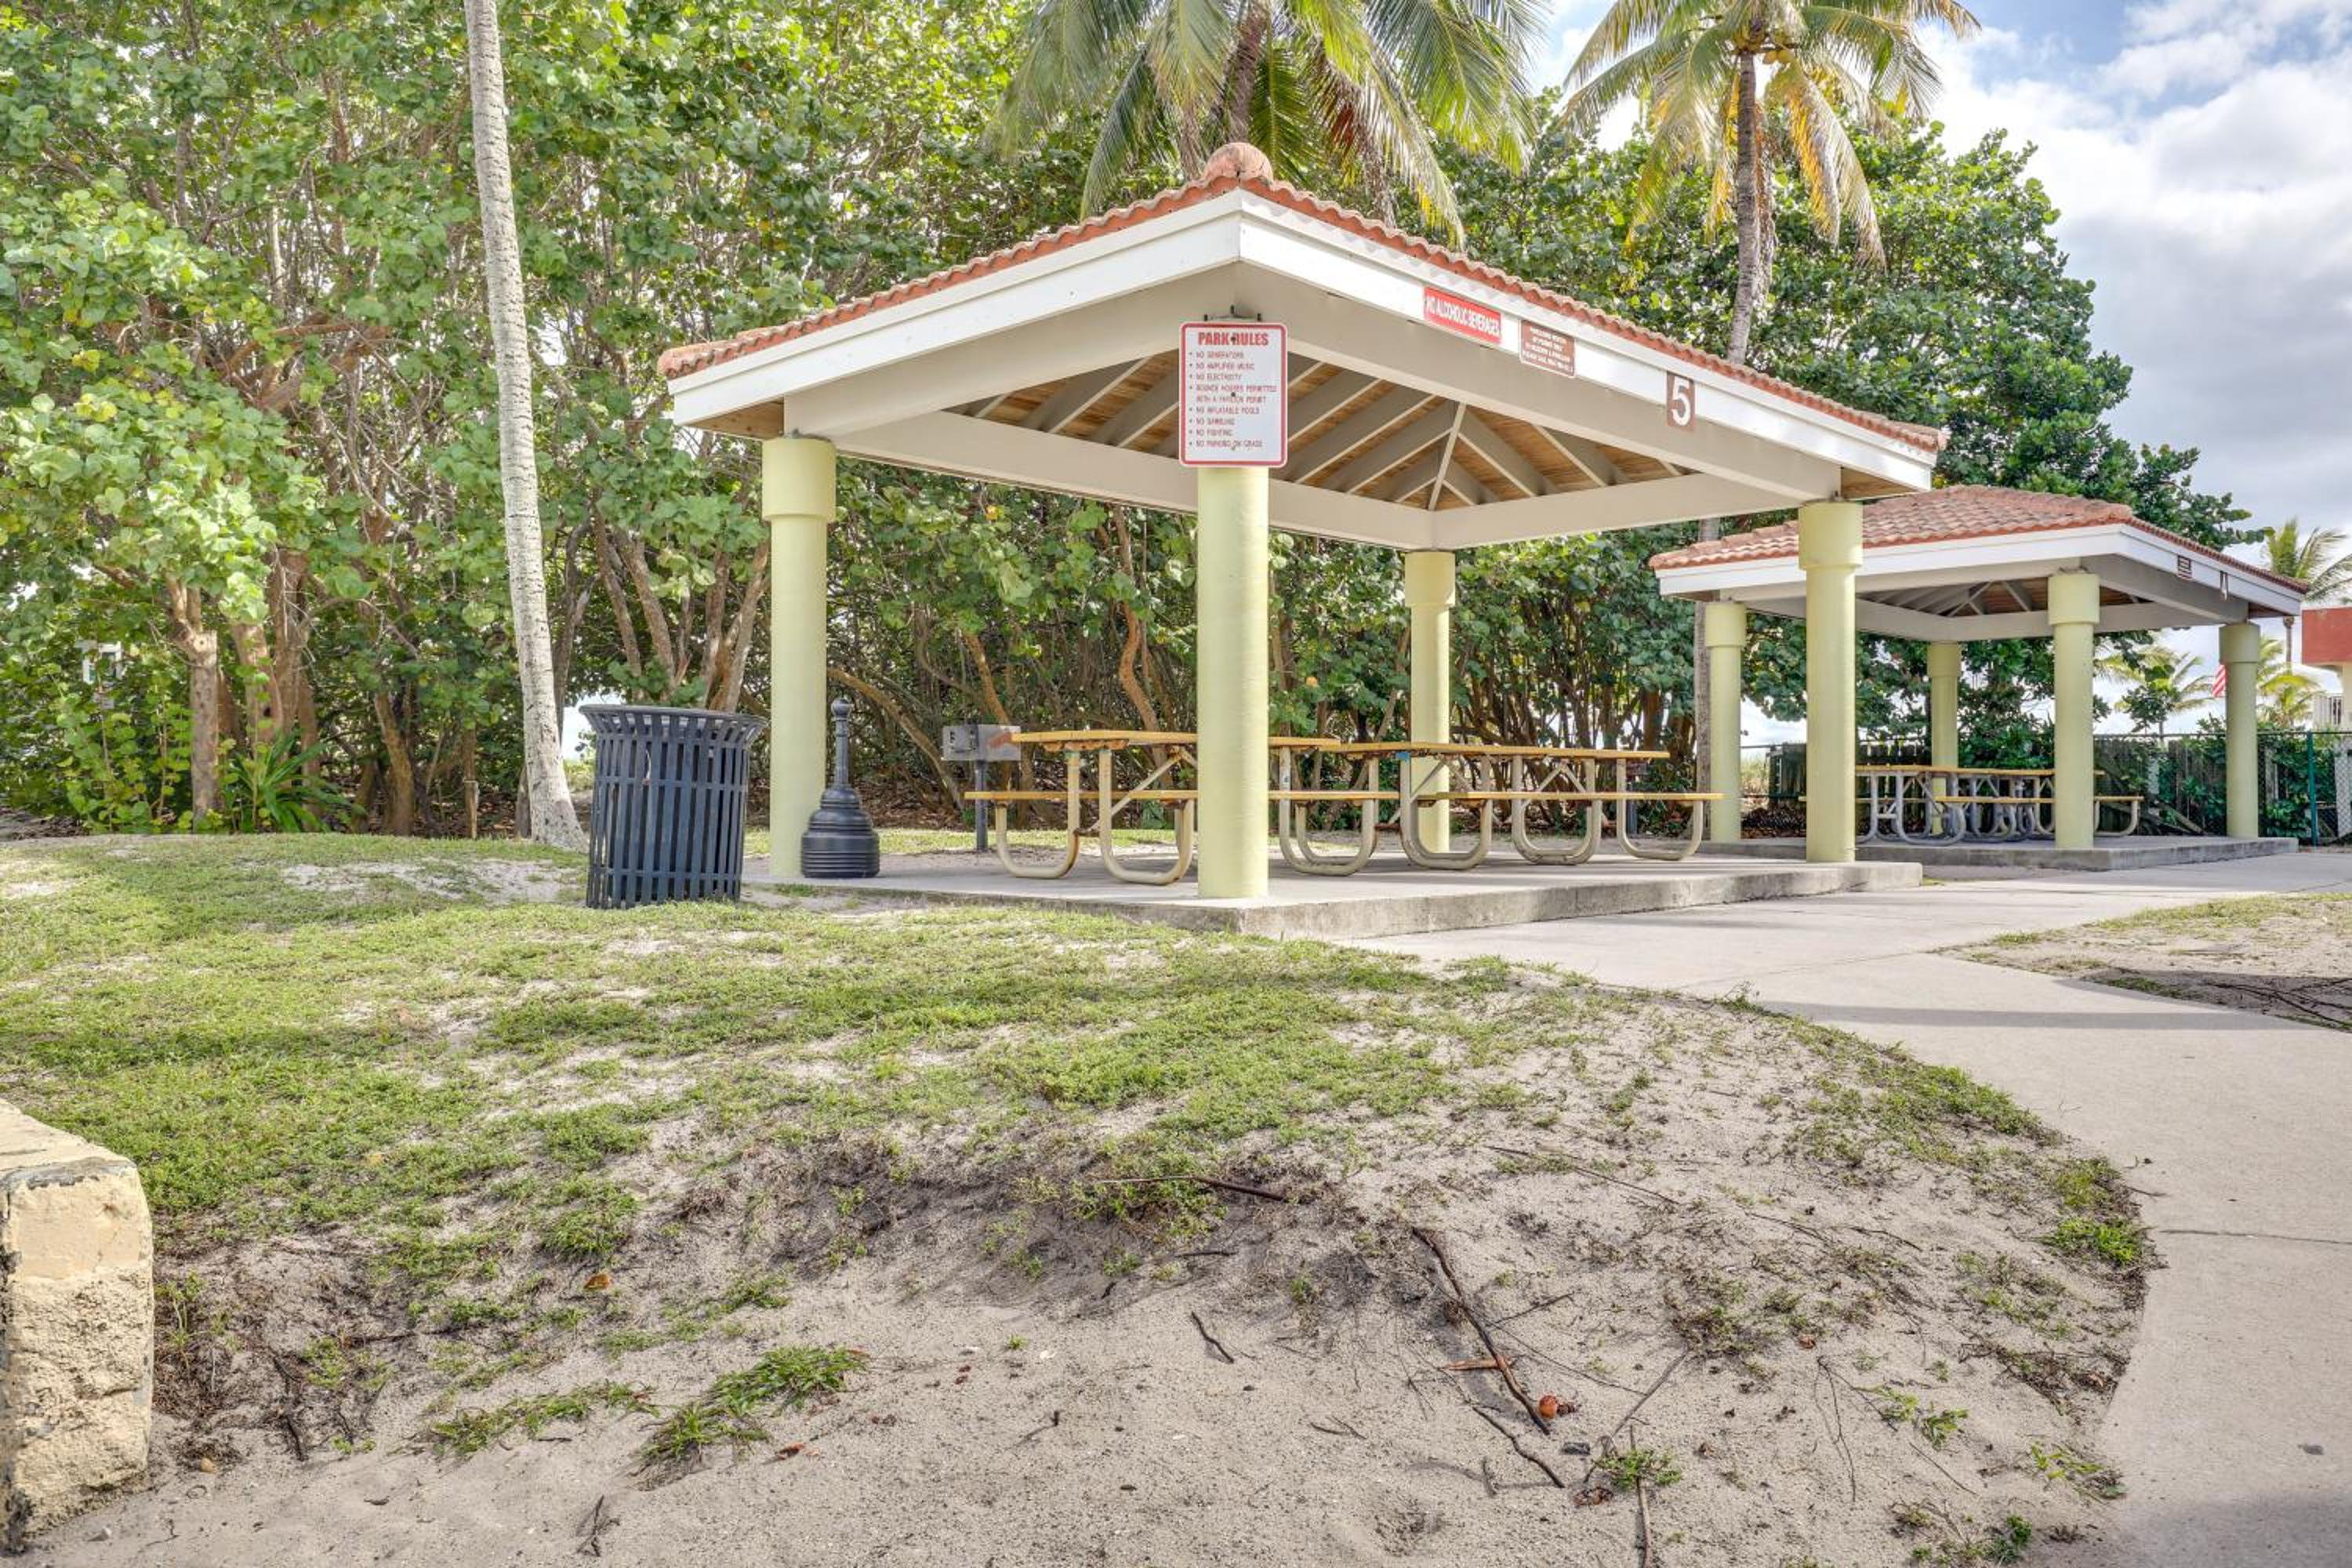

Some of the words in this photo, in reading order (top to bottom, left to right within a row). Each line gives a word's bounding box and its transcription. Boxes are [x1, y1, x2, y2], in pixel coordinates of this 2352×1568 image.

[1198, 332, 1230, 346] PARK
[1232, 332, 1269, 347] RULES
[1196, 350, 1205, 359] NO
[1196, 361, 1205, 370] NO
[1196, 372, 1205, 381] NO
[1671, 375, 1691, 426] 5
[1196, 406, 1205, 415] NO
[1196, 417, 1205, 426] NO
[1196, 428, 1205, 437] NO
